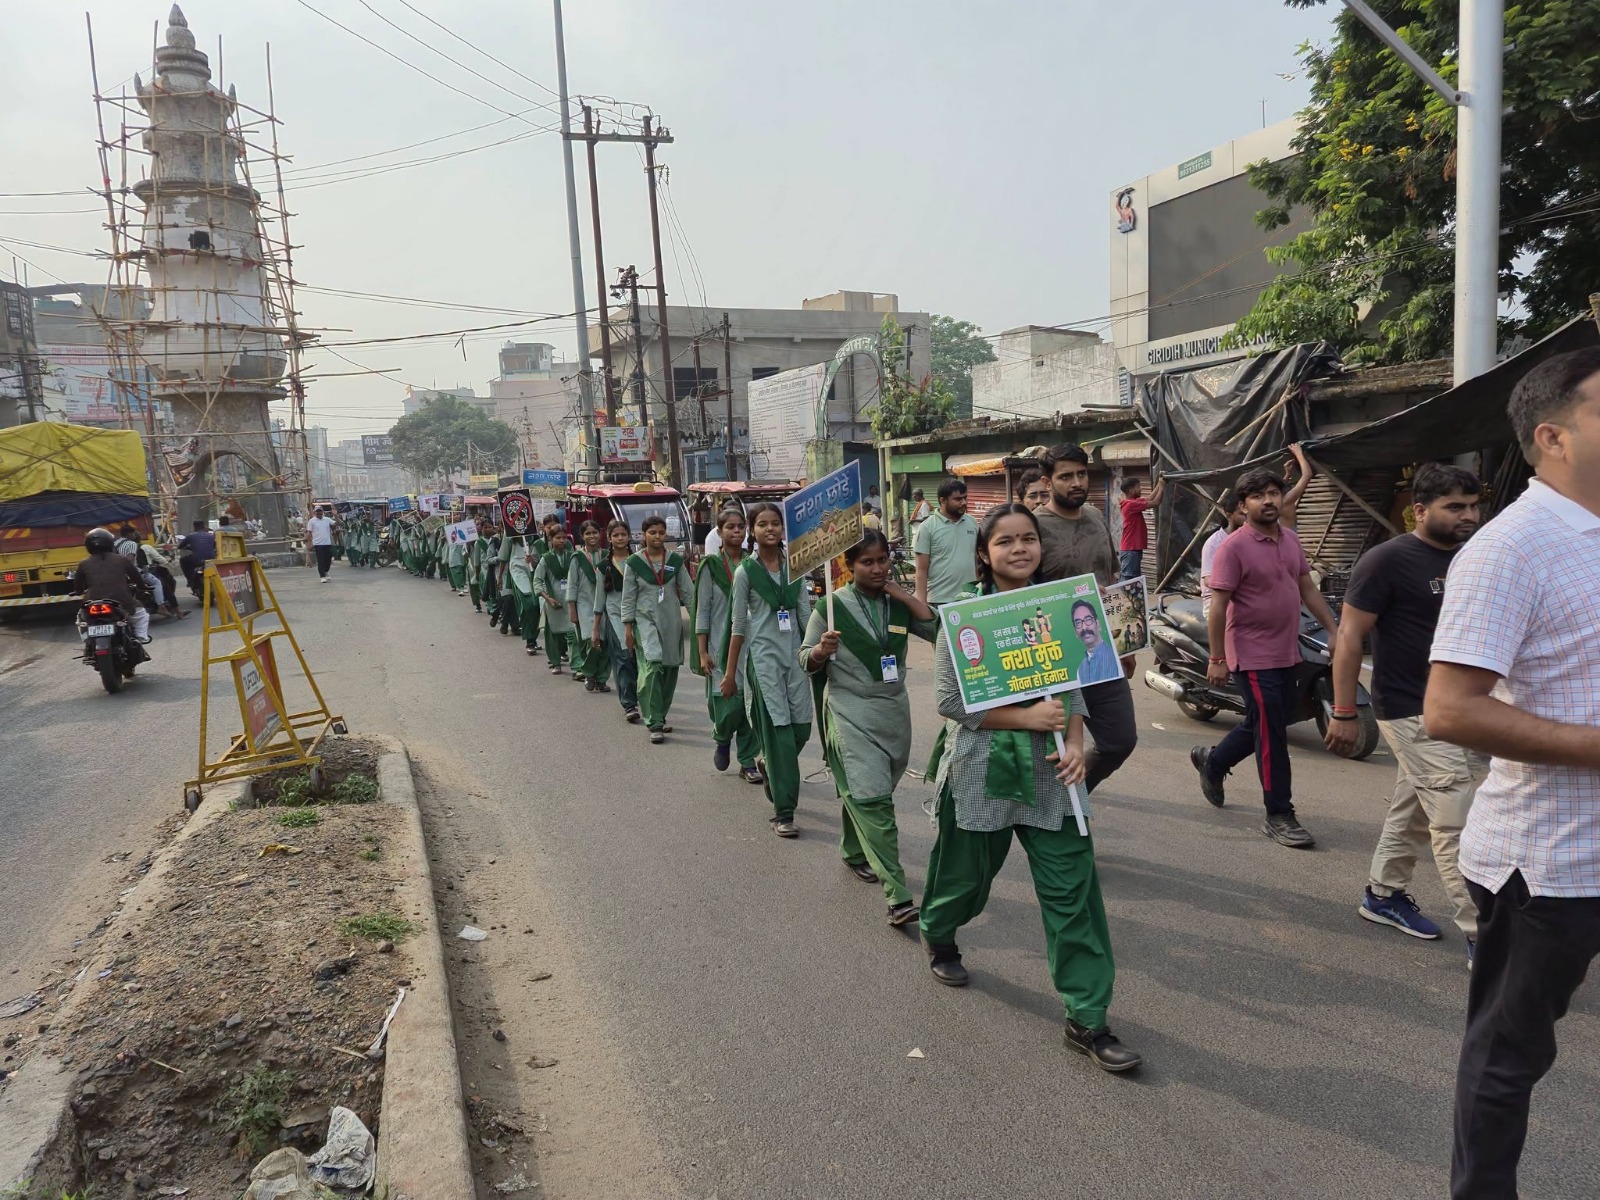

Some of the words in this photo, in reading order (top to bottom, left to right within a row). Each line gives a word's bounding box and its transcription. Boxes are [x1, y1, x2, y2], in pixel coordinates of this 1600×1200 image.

[1147, 343, 1182, 364] GIRIDIH
[794, 491, 823, 523] नशा
[998, 646, 1034, 671] नशा
[1031, 640, 1063, 671] मुक्त
[1006, 675, 1033, 693] जीवन
[1032, 670, 1043, 687] हो
[1042, 667, 1069, 685] हमारा
